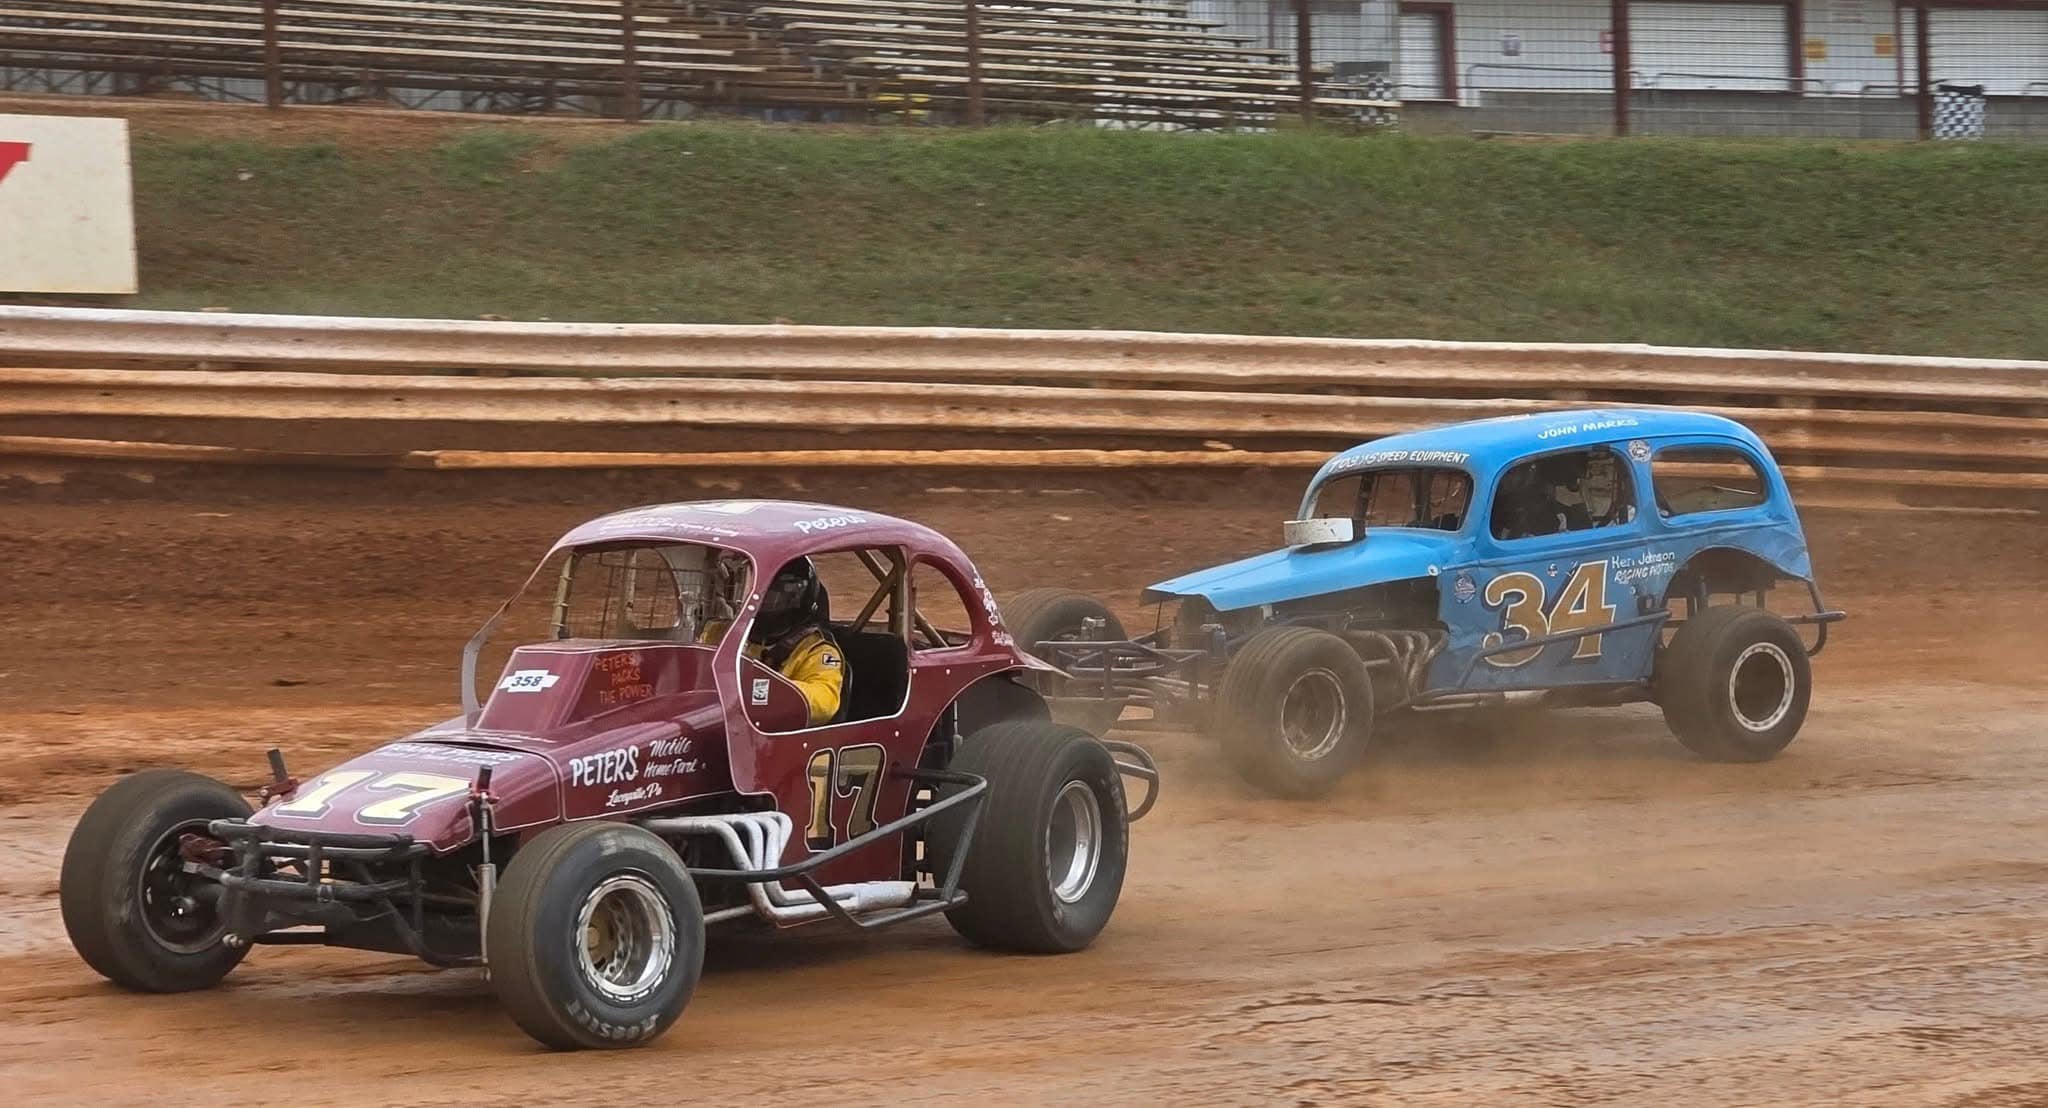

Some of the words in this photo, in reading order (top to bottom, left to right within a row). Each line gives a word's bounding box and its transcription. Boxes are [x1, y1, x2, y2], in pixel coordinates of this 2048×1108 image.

[1537, 425, 1577, 439] JOHN
[1583, 418, 1639, 432] MARKS
[1376, 450, 1408, 464] SPEED
[1409, 450, 1470, 465] EQUIPMENT
[1482, 560, 1617, 667] 34
[510, 675, 543, 688] 358
[600, 690, 617, 704] THE
[618, 684, 653, 702] POWER
[569, 745, 640, 787] PETERS
[272, 769, 473, 827] 17
[804, 742, 887, 853] 17
